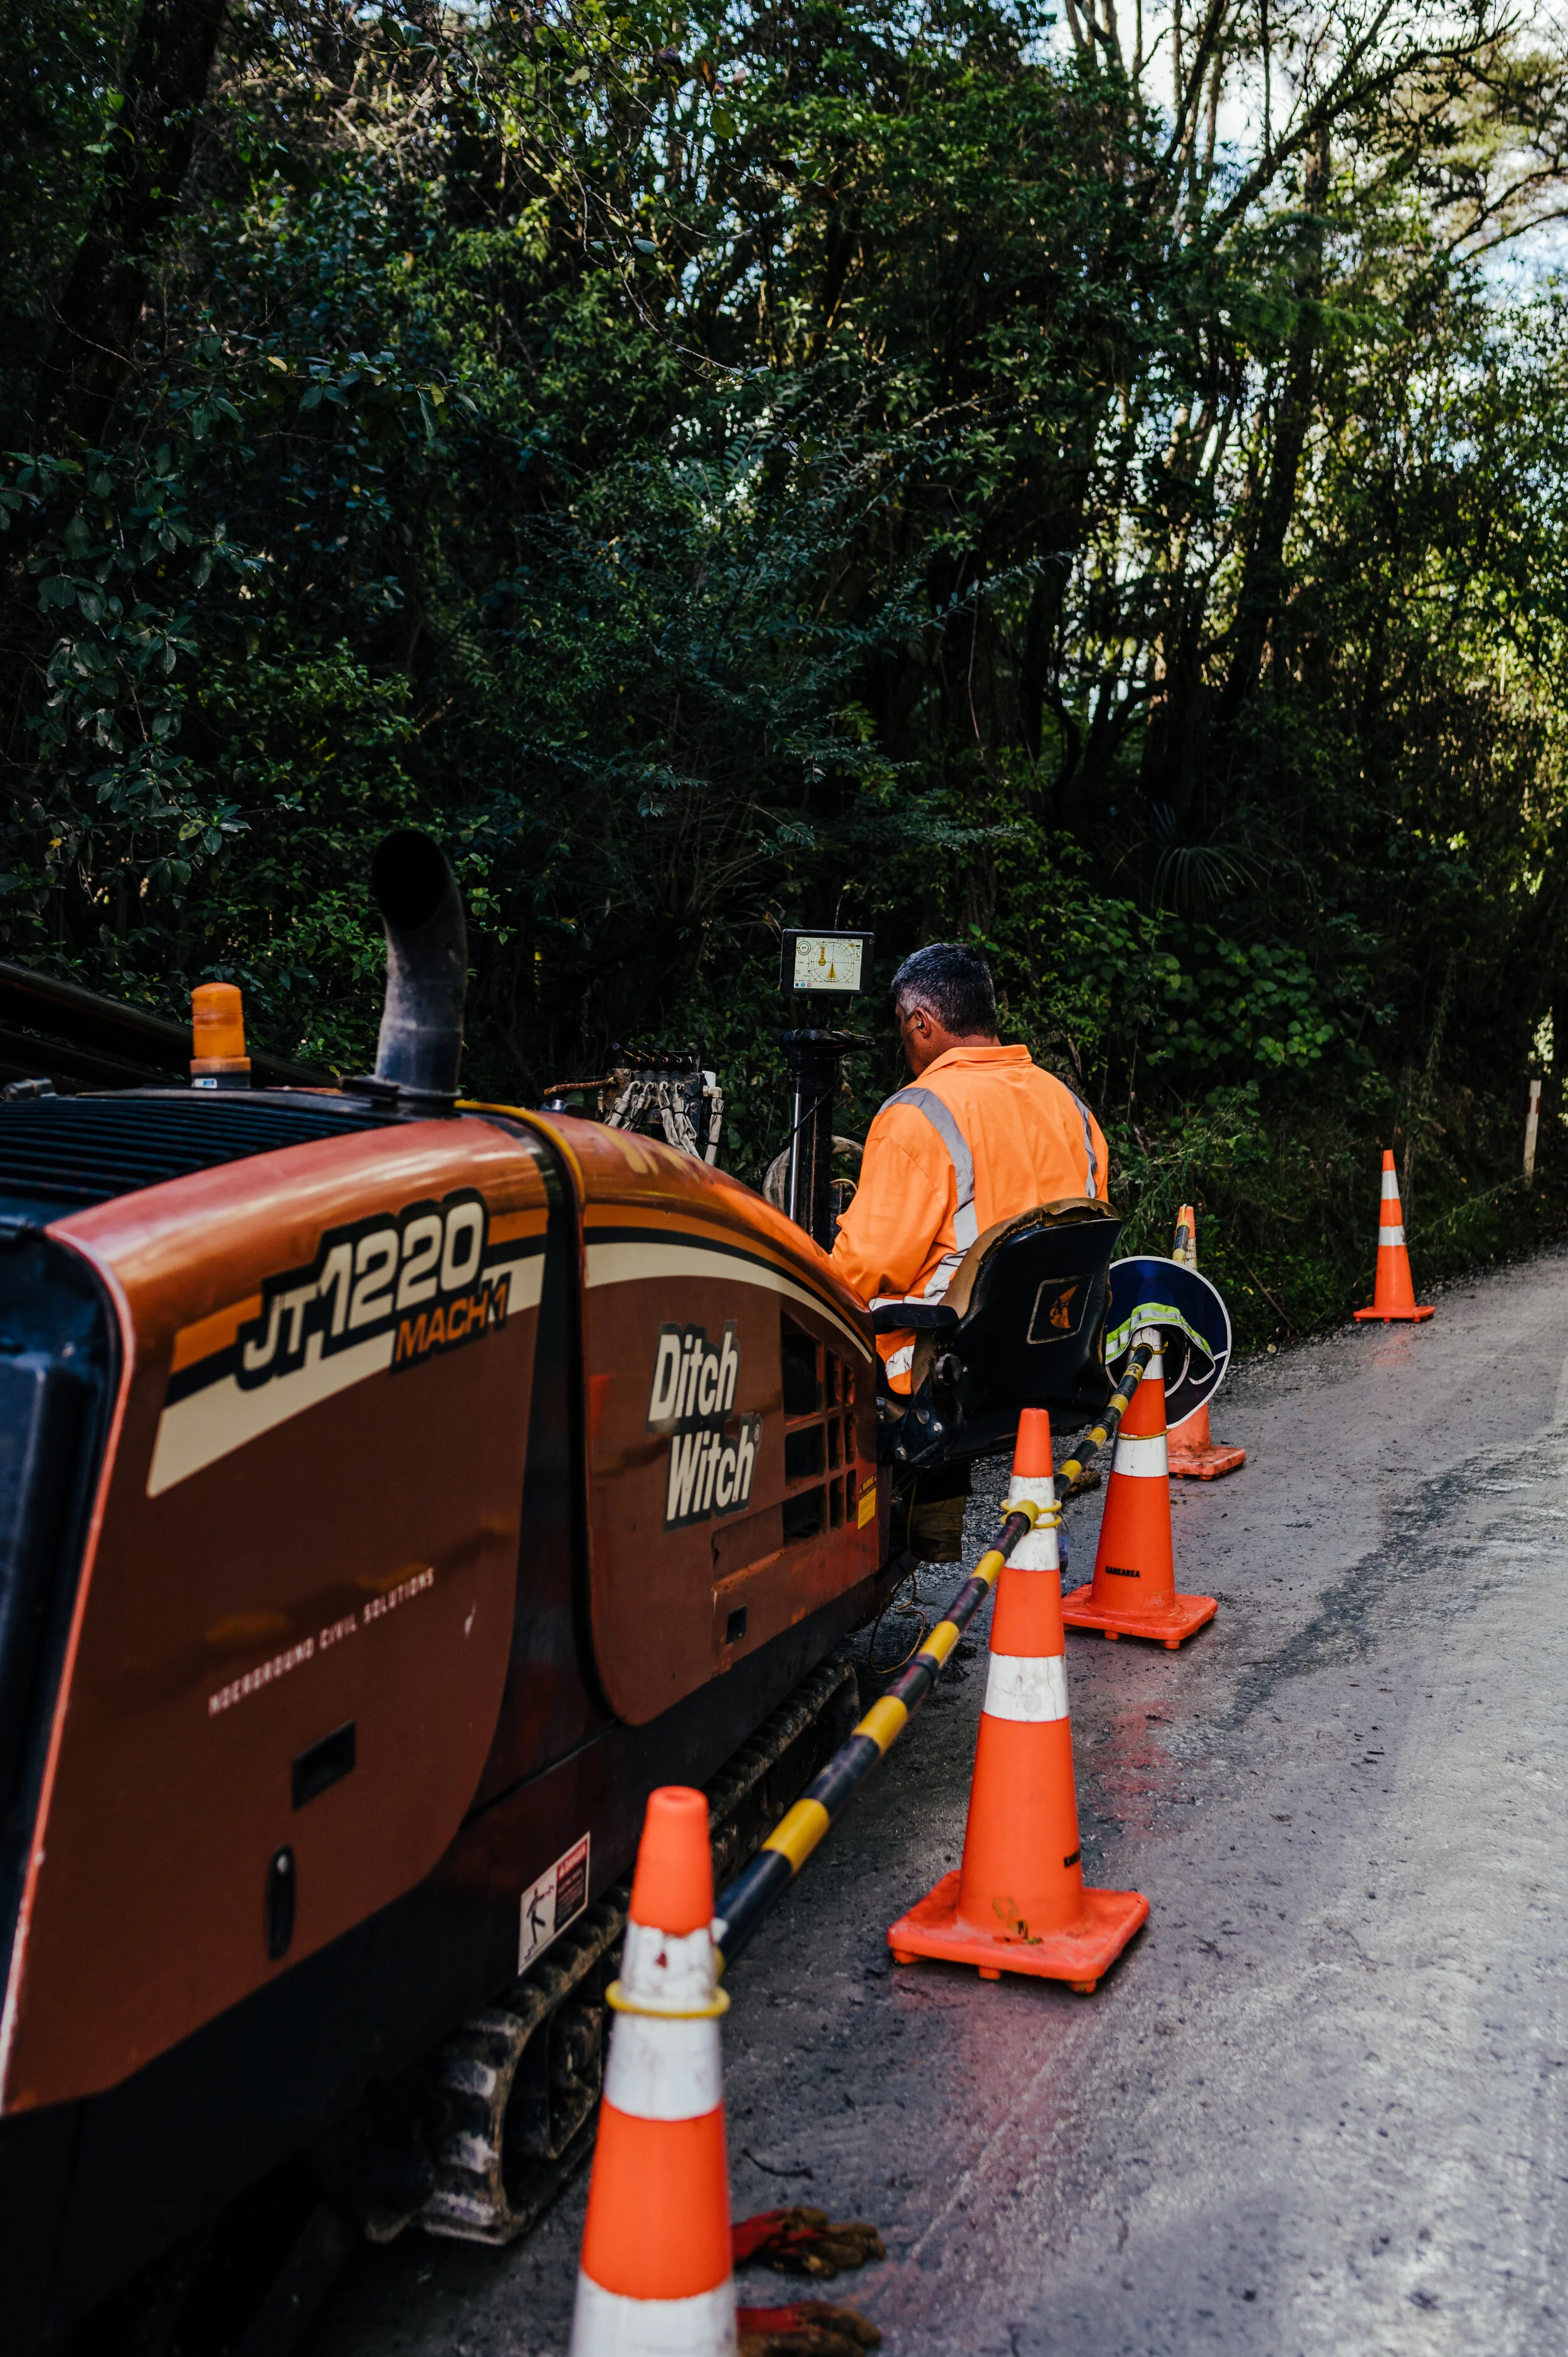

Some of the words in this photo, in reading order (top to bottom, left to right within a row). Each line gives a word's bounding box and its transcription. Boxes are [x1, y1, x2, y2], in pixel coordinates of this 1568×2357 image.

[243, 1201, 484, 1372] JT1220
[395, 1294, 487, 1361] MACH
[648, 1331, 739, 1422] Ditch
[666, 1424, 754, 1522] Witch
